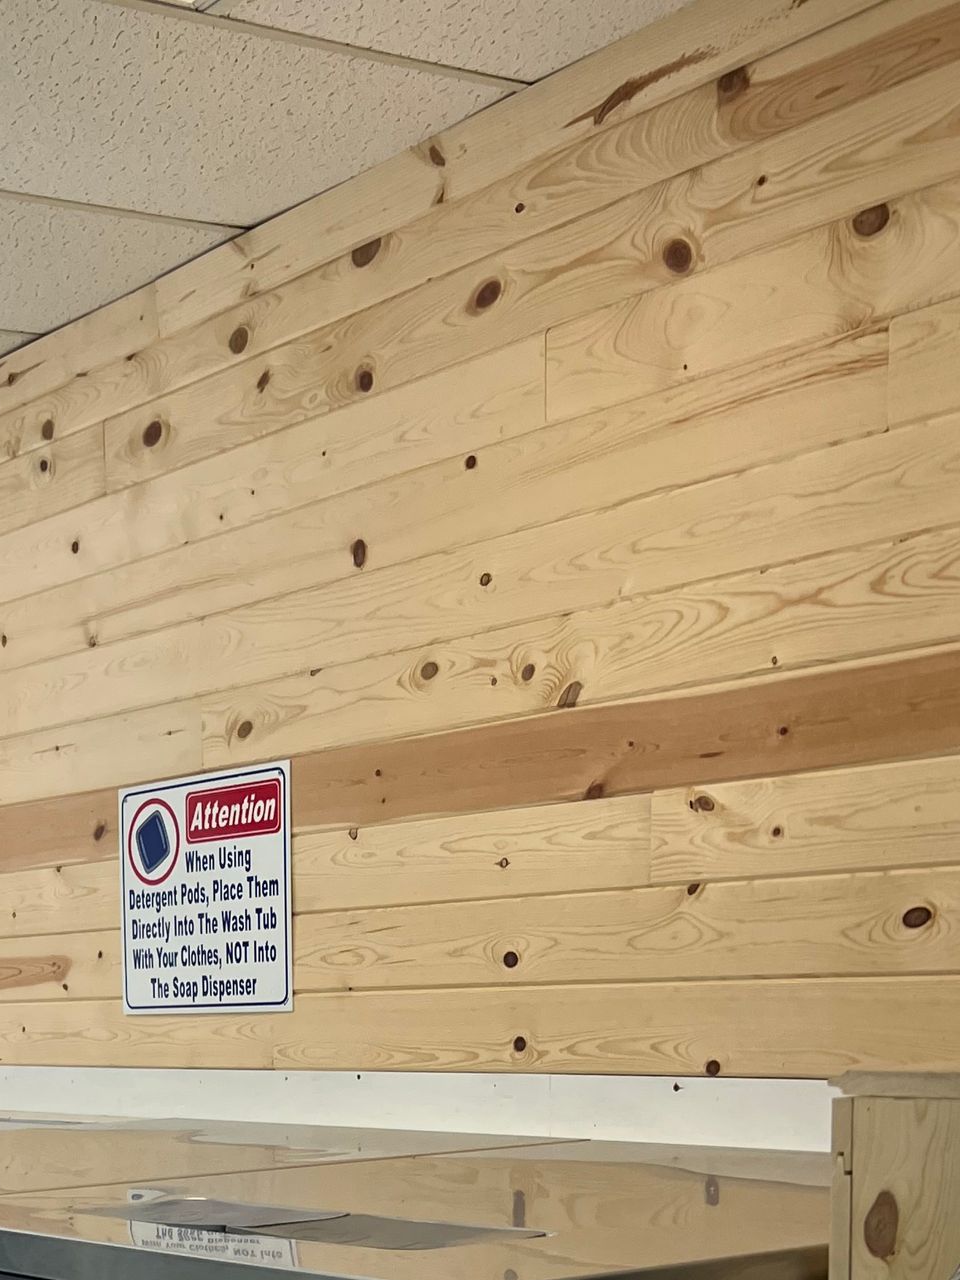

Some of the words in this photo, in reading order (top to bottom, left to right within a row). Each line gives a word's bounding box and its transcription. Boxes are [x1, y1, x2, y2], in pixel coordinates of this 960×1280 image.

[190, 794, 276, 832] Attention
[185, 850, 215, 873] When
[218, 845, 251, 872] Using
[129, 886, 177, 913] Detergent
[181, 882, 209, 907] Pods,
[213, 879, 243, 902] Place
[247, 875, 279, 898] Them
[131, 915, 170, 943] Directly
[174, 915, 194, 936] Into
[198, 913, 218, 935] The
[221, 909, 251, 932] Wash
[255, 907, 277, 930] Tub
[132, 947, 154, 970] With
[156, 946, 177, 969] Your
[181, 944, 222, 970] Clothes,
[225, 941, 249, 965] NOT
[253, 940, 277, 963] Into
[151, 977, 169, 999] The
[172, 976, 198, 1002] Soap
[202, 975, 257, 1002] Dispenser
